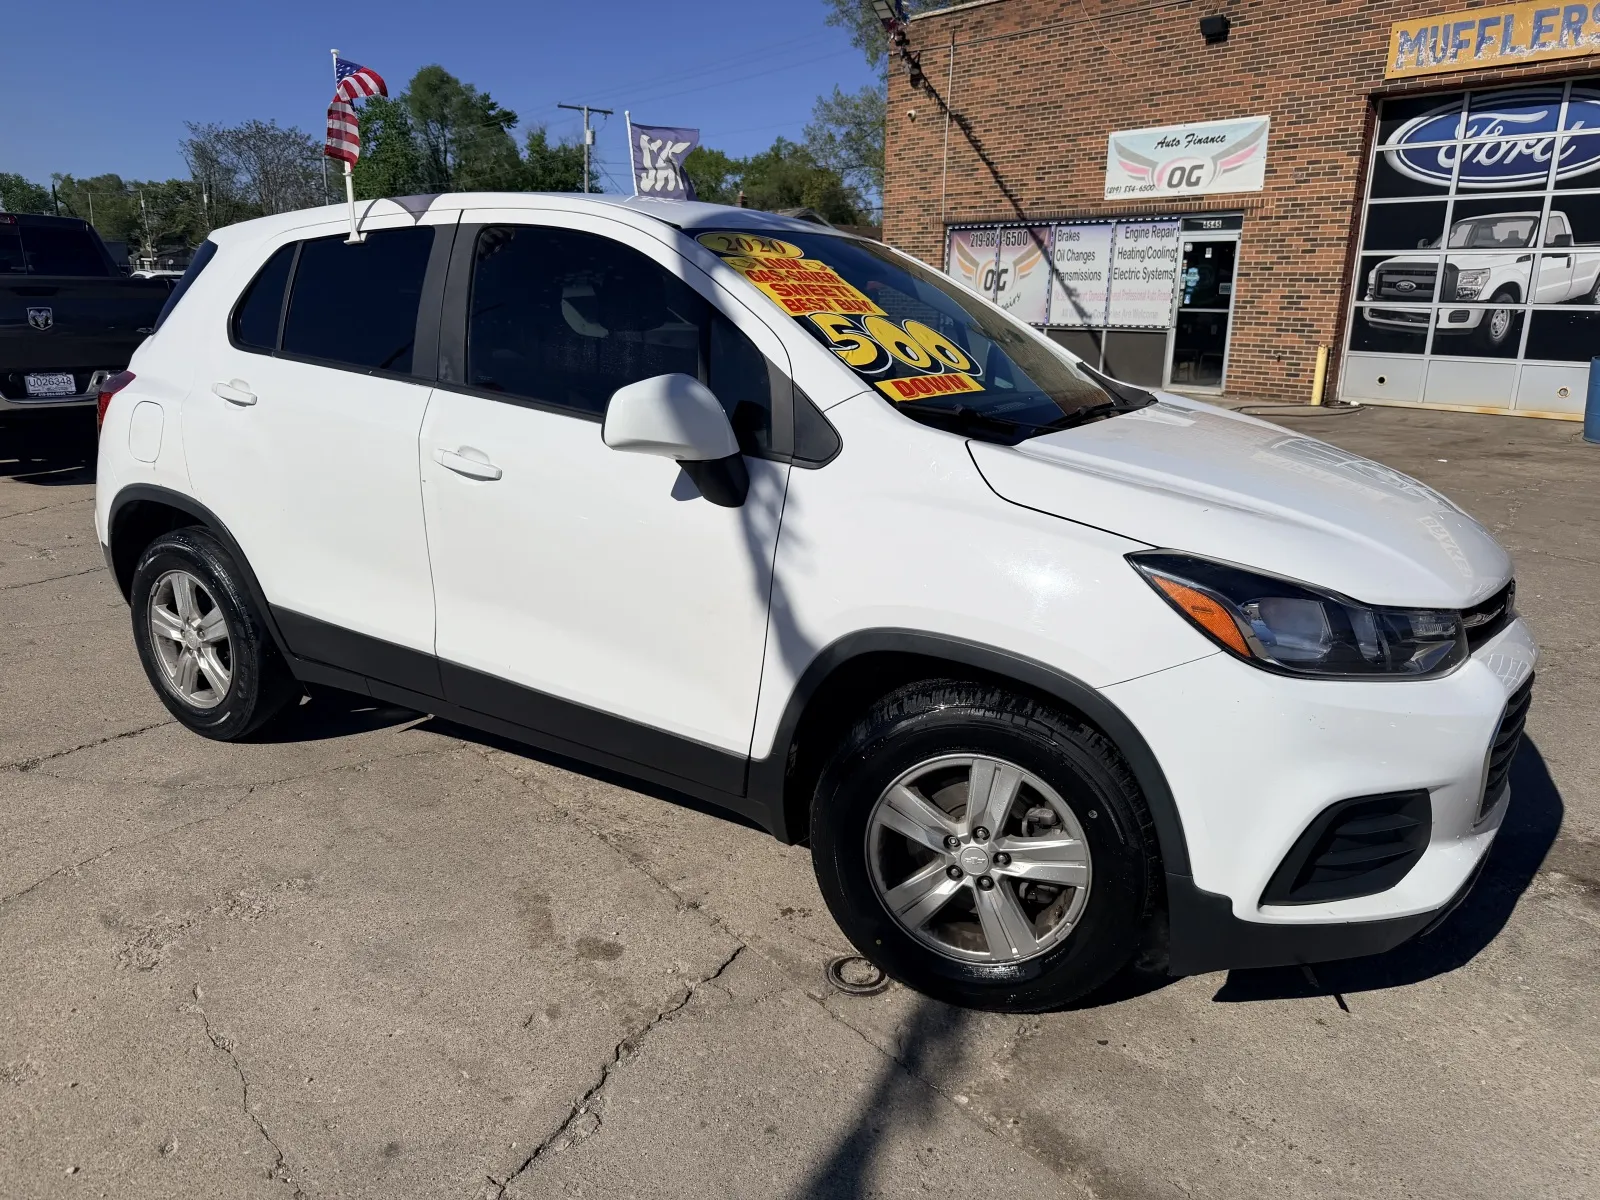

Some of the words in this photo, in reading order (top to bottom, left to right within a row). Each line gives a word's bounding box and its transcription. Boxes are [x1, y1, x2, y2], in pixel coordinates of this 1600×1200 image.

[1154, 136, 1180, 150] Auto
[1184, 132, 1226, 148] Finance
[1438, 110, 1585, 168] Ford
[1167, 164, 1205, 188] OG
[1057, 229, 1081, 242] Brakes
[1124, 226, 1150, 242] Engine
[1151, 224, 1177, 240] Repair
[719, 236, 787, 256] 2020
[1117, 244, 1176, 262] Heating/Cooling
[753, 257, 807, 270] LOOK
[1055, 250, 1065, 262] Oil
[1066, 248, 1096, 264] Changes
[1113, 267, 1140, 280] Electric
[1141, 266, 1174, 283] Systems
[781, 297, 836, 313] BEST
[834, 298, 875, 314] BUY
[805, 312, 984, 376] 500
[28, 376, 72, 387] U026348
[890, 374, 971, 399] DOWN
